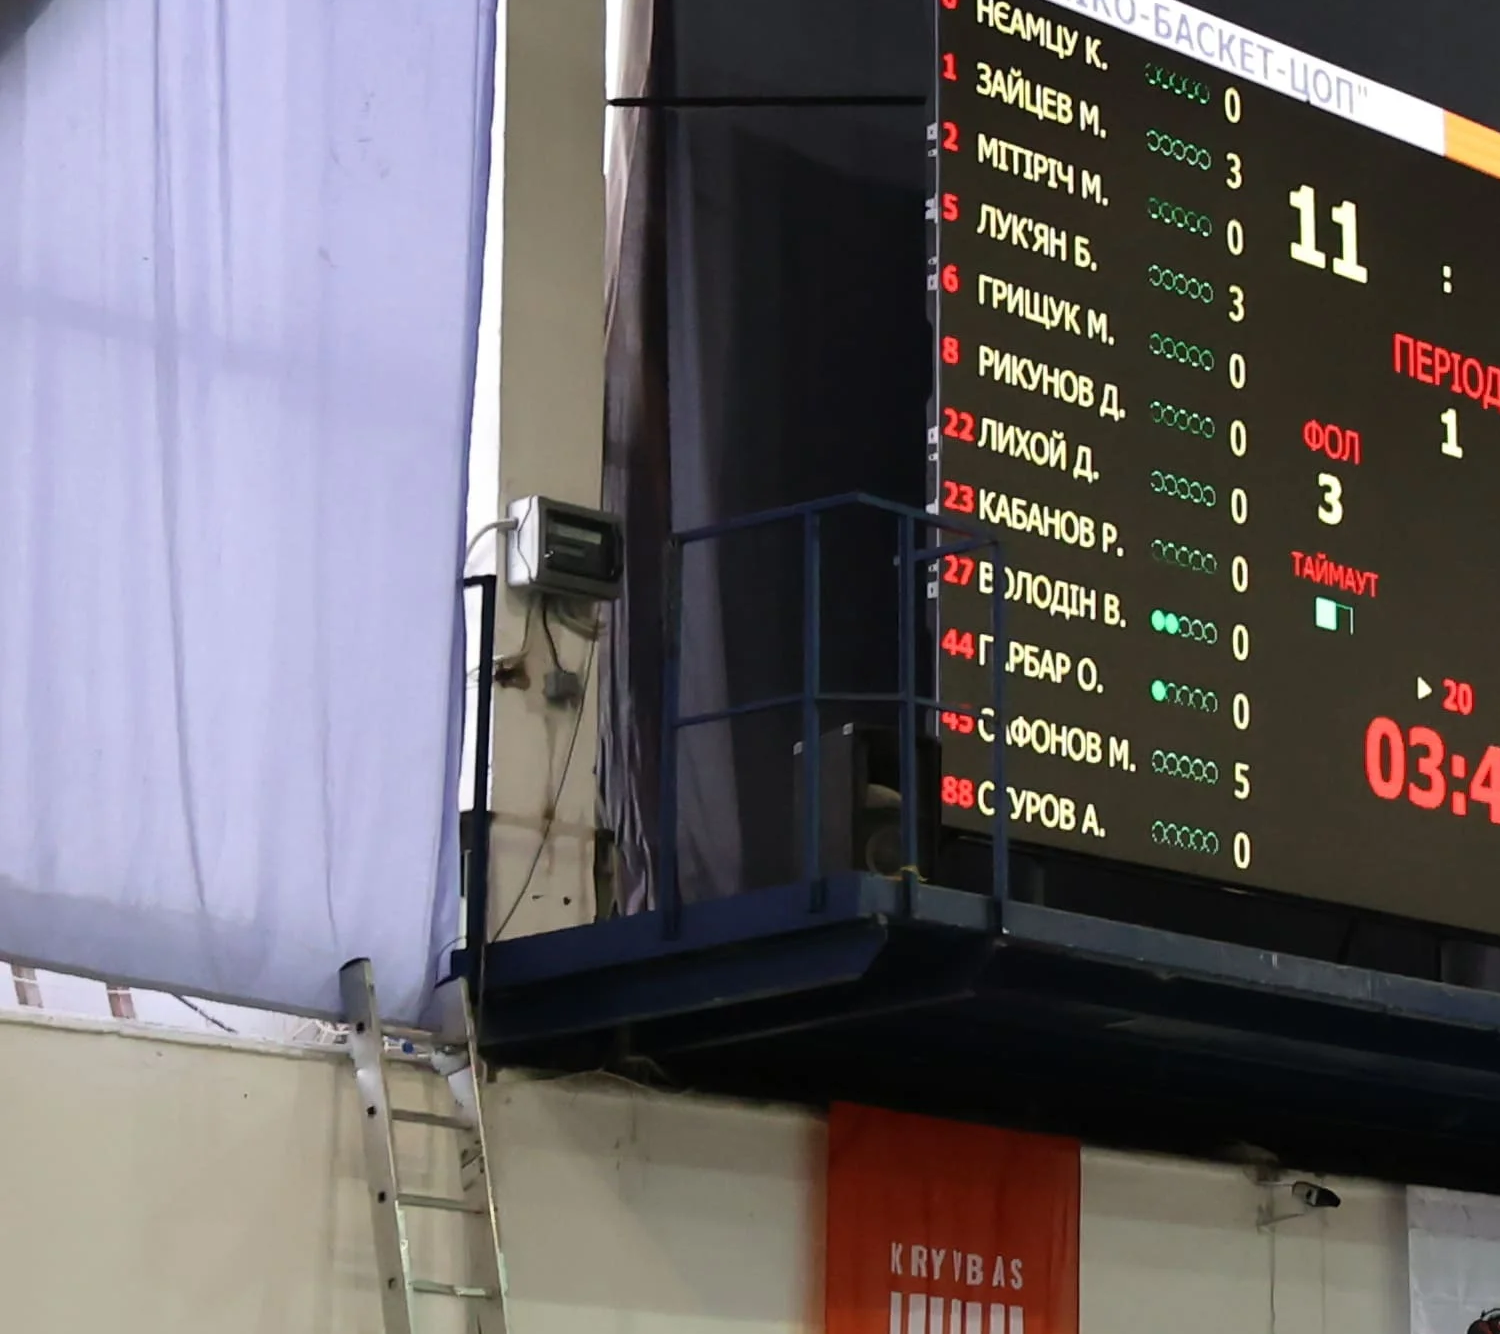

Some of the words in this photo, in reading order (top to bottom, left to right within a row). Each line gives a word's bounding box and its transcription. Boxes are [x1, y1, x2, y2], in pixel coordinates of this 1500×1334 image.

[943, 53, 957, 80] 1
[976, 62, 1073, 124] ЗАЙЦЕВ
[1080, 100, 1107, 139] М.
[1225, 152, 1242, 190] 3
[1085, 35, 1108, 71] К.
[1224, 87, 1241, 123] 0
[943, 122, 958, 151] 2
[977, 133, 1074, 194] МІТІРІЧ
[1081, 170, 1108, 206] М.
[1227, 220, 1243, 255] 0
[1289, 184, 1368, 283] 11
[943, 193, 958, 221] 5
[977, 203, 1067, 262] ЛУК'ЯН
[1074, 235, 1097, 271] Б.
[1229, 286, 1244, 322] 3
[942, 264, 958, 293] 6
[978, 273, 1081, 335] ГРИЩУК
[1087, 309, 1115, 346] М.
[1229, 353, 1246, 389] 0
[942, 336, 958, 365] 8
[979, 345, 1094, 409] РИКУНОВ
[1099, 382, 1126, 422] Д.
[1230, 420, 1247, 457] 0
[1303, 419, 1361, 465] ФОЛ
[1441, 408, 1463, 459] 1
[943, 407, 975, 442] 22
[977, 417, 1066, 470] ЛИХОЙ
[1072, 445, 1100, 484] Д.
[1231, 488, 1248, 524] 0
[1318, 472, 1344, 525] 3
[943, 480, 975, 513] 23
[979, 488, 1095, 550] КАБАНОВ
[1103, 522, 1124, 557] Р.
[1232, 556, 1248, 592] 0
[1291, 551, 1379, 598] ТАЙМАУТ
[943, 554, 975, 586] 27
[978, 561, 1096, 620] ВЛОДІН
[1103, 593, 1126, 628] В.
[1232, 624, 1249, 661] 0
[941, 627, 975, 659] 44
[978, 633, 1071, 684] ГРБАР
[1077, 657, 1104, 694] О.
[1233, 693, 1250, 730] 0
[1442, 678, 1474, 716] 20
[977, 707, 1102, 764] СФОНОВ
[1108, 736, 1137, 772] М.
[1233, 763, 1250, 799] 5
[941, 775, 975, 809] 88
[1081, 803, 1106, 838] А.
[1233, 832, 1250, 868] 0
